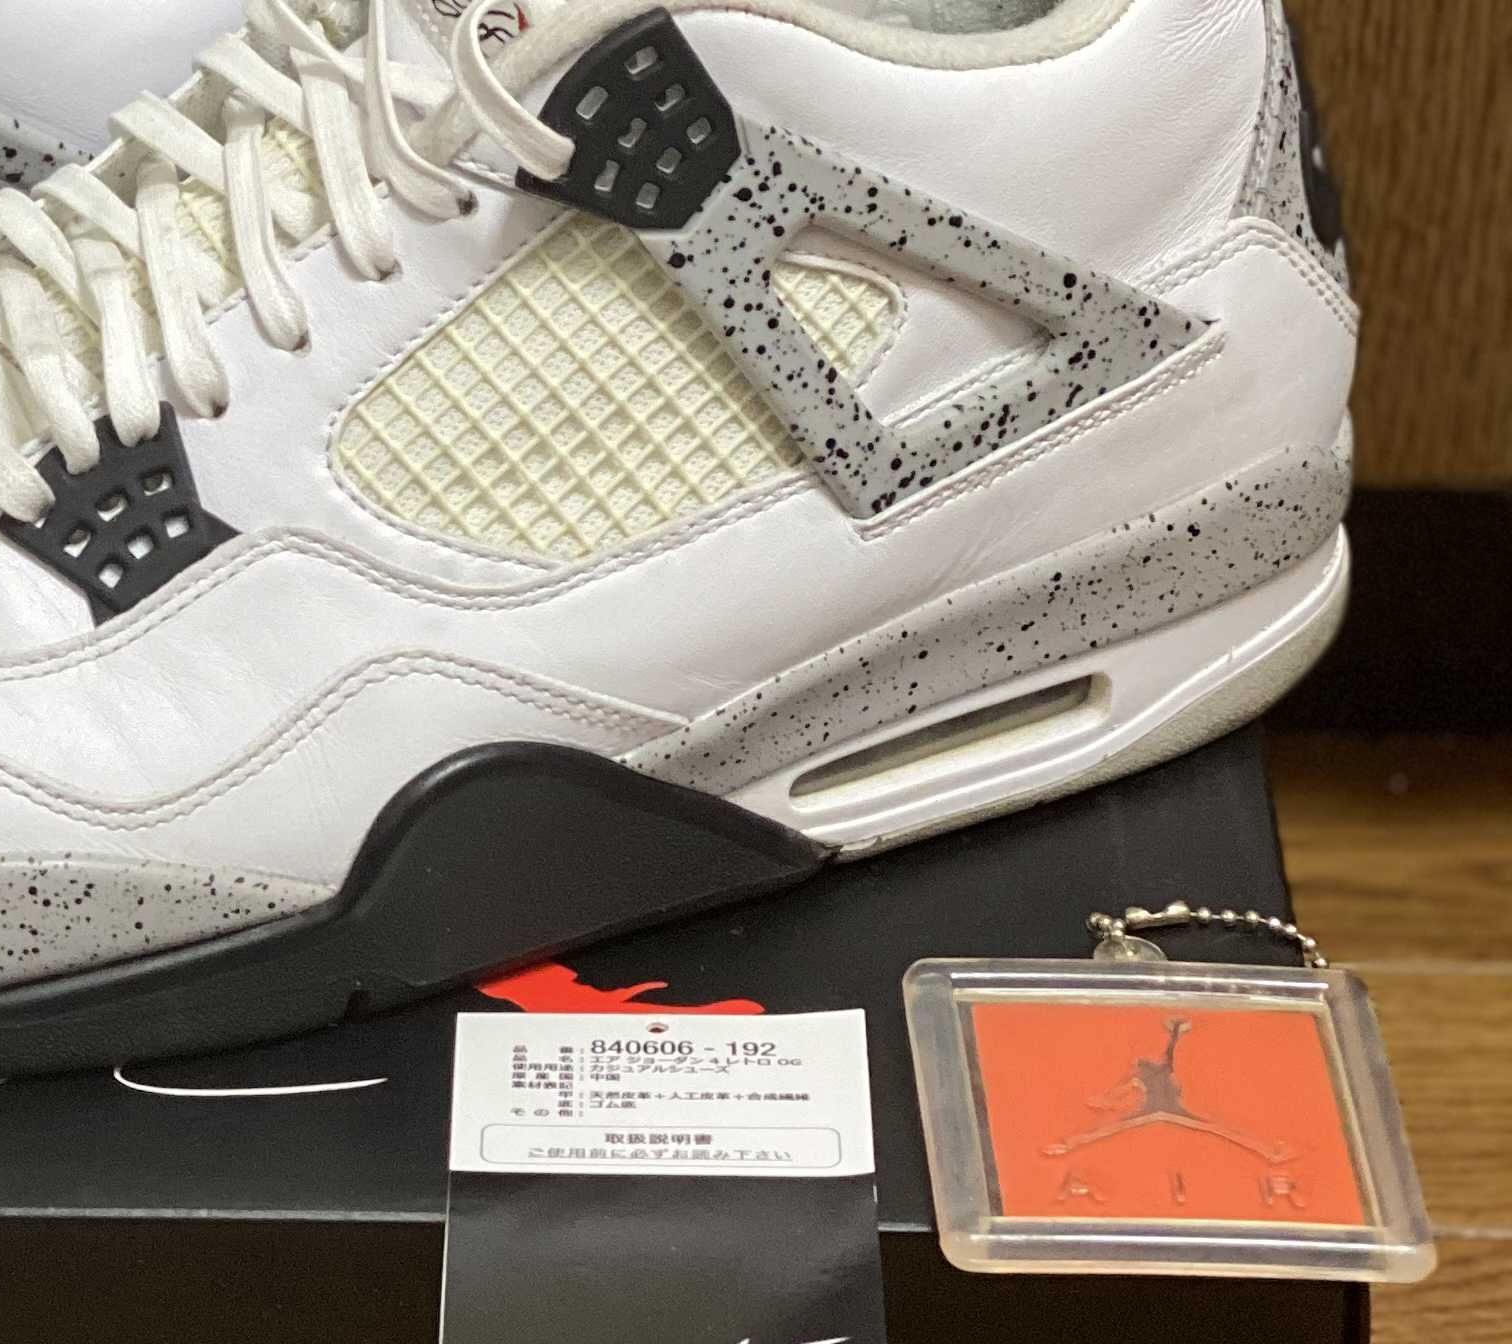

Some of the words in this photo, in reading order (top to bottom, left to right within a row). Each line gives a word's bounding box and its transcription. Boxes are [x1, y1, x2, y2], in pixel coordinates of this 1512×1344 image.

[590, 1039, 694, 1055] 840606
[726, 1041, 777, 1057] 192
[604, 1132, 714, 1145] 取扱説明書
